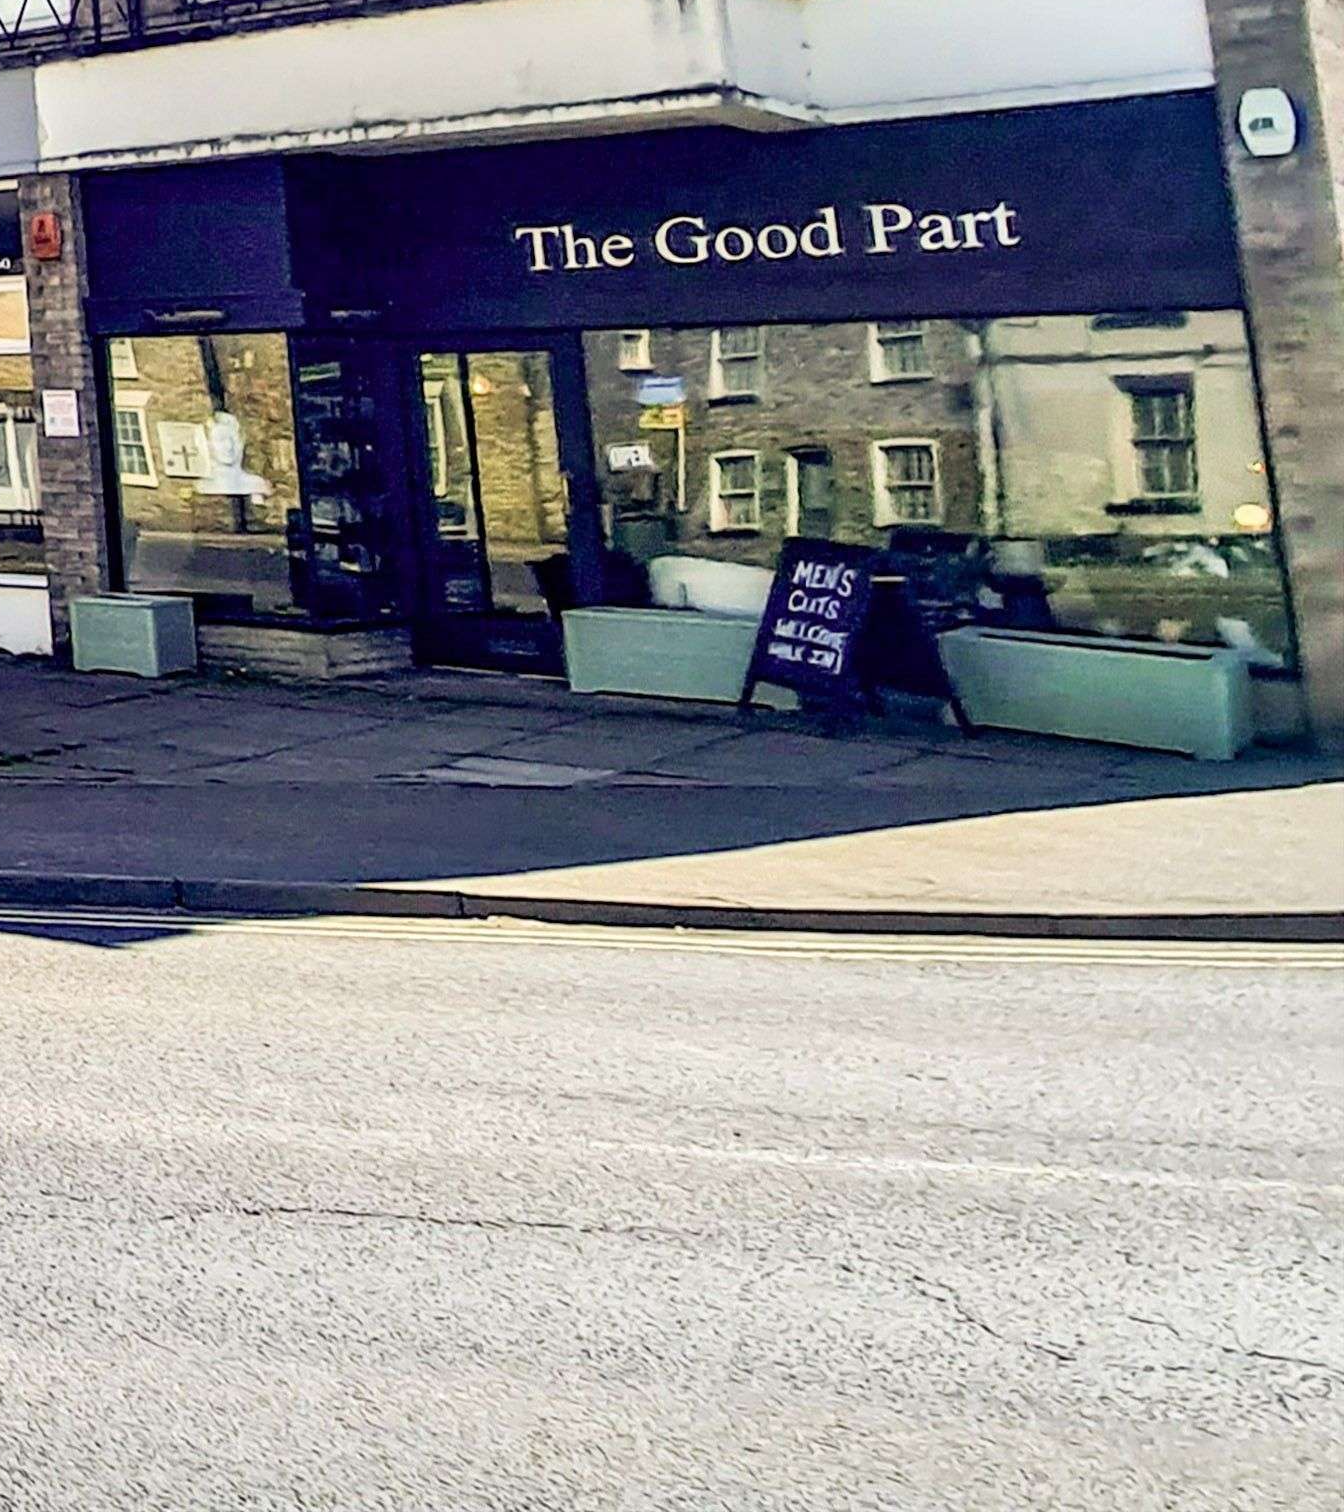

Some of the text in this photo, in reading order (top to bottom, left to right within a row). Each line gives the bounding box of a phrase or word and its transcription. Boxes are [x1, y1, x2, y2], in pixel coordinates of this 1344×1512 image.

[514, 201, 1021, 272] The Good Part
[787, 589, 840, 620] CUTS
